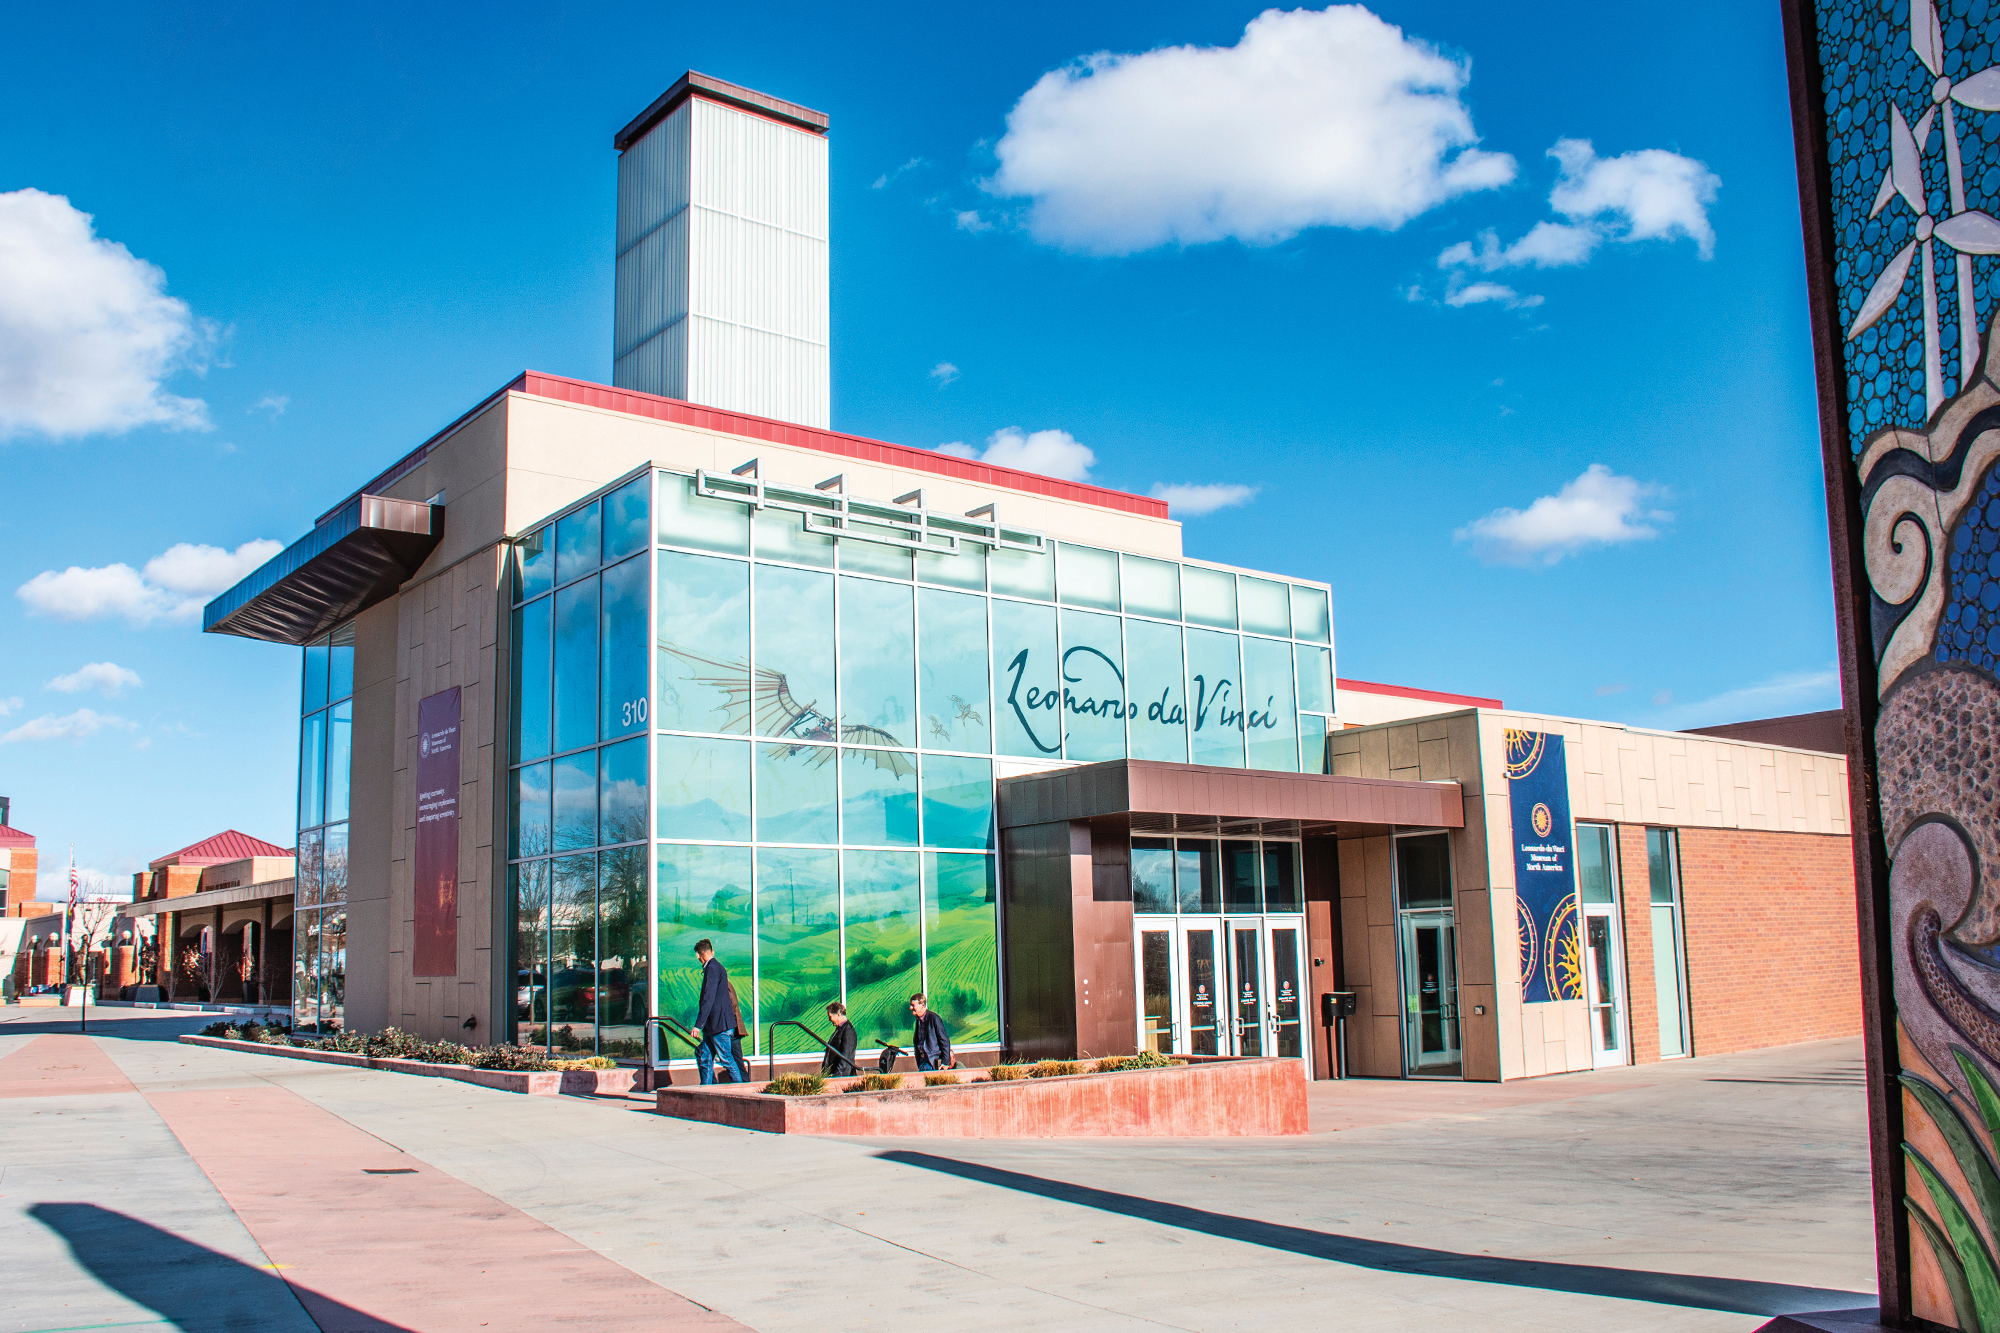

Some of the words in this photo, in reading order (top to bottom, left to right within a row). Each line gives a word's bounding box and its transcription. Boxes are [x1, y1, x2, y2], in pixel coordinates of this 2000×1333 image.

[1007, 645, 1138, 753] Leonardo
[1148, 686, 1185, 725] da
[1193, 674, 1278, 732] Vinci
[622, 697, 647, 727] 310
[1521, 843, 1546, 852] Leonardo
[1545, 844, 1553, 852] da
[1552, 844, 1565, 853] Vinci
[1530, 853, 1552, 861] Museum
[1552, 853, 1558, 862] of
[1526, 862, 1541, 871] North
[1541, 863, 1564, 871] America
